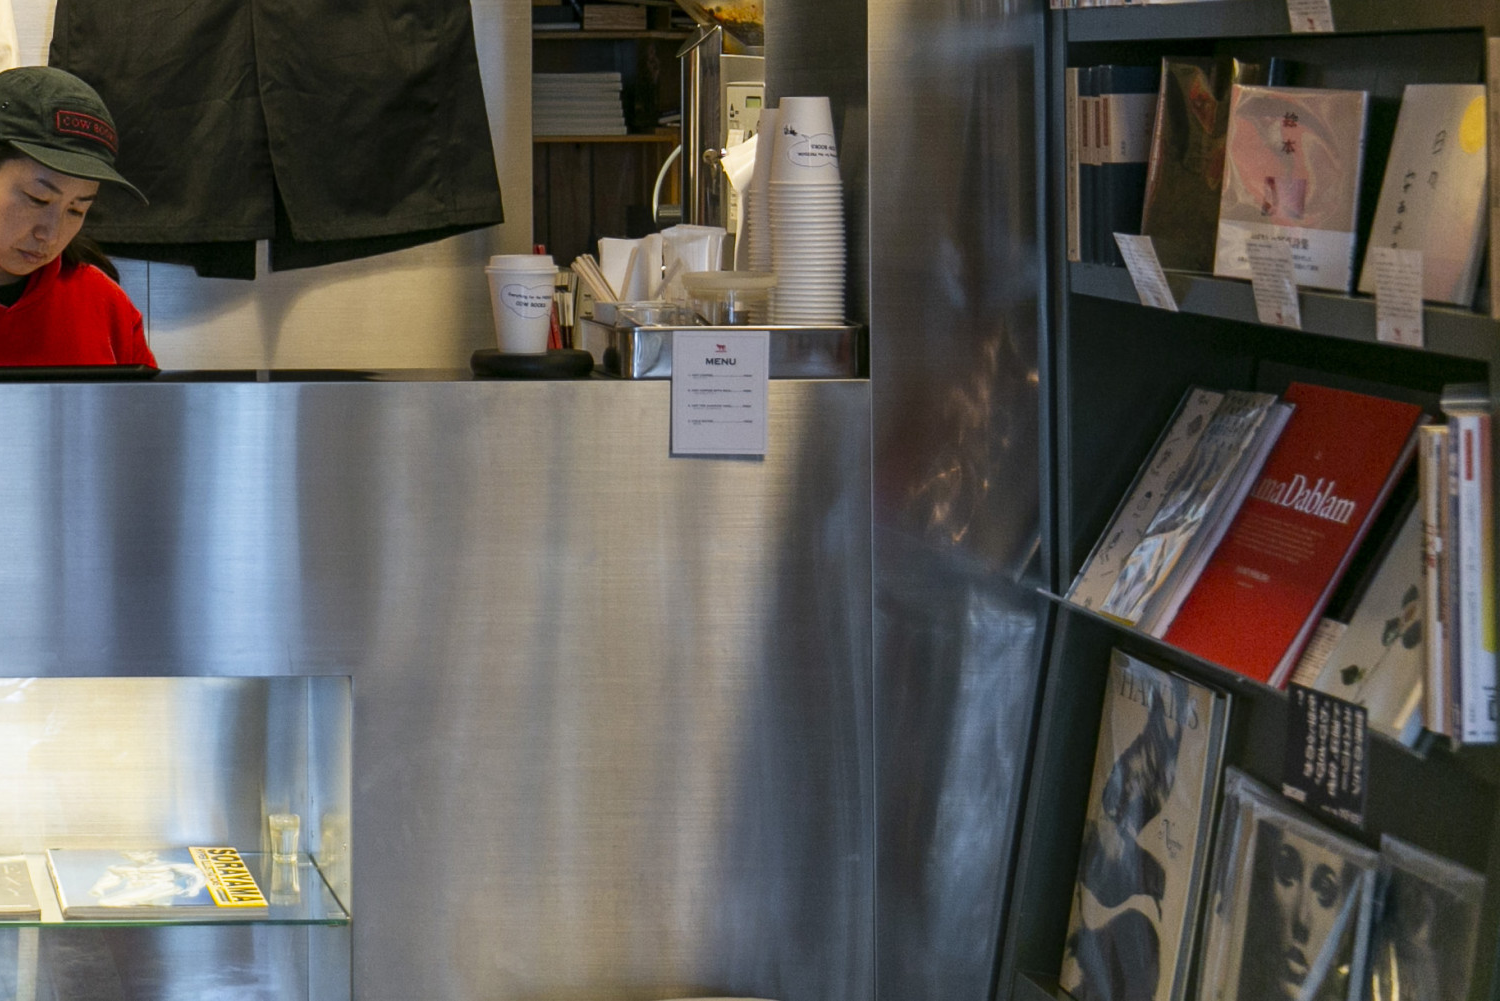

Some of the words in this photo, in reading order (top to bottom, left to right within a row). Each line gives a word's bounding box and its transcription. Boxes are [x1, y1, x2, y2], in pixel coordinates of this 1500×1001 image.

[62, 116, 92, 131] COW
[705, 357, 737, 366] MENU
[1250, 473, 1356, 525] maDablam
[207, 848, 265, 903] SORAYAMA
